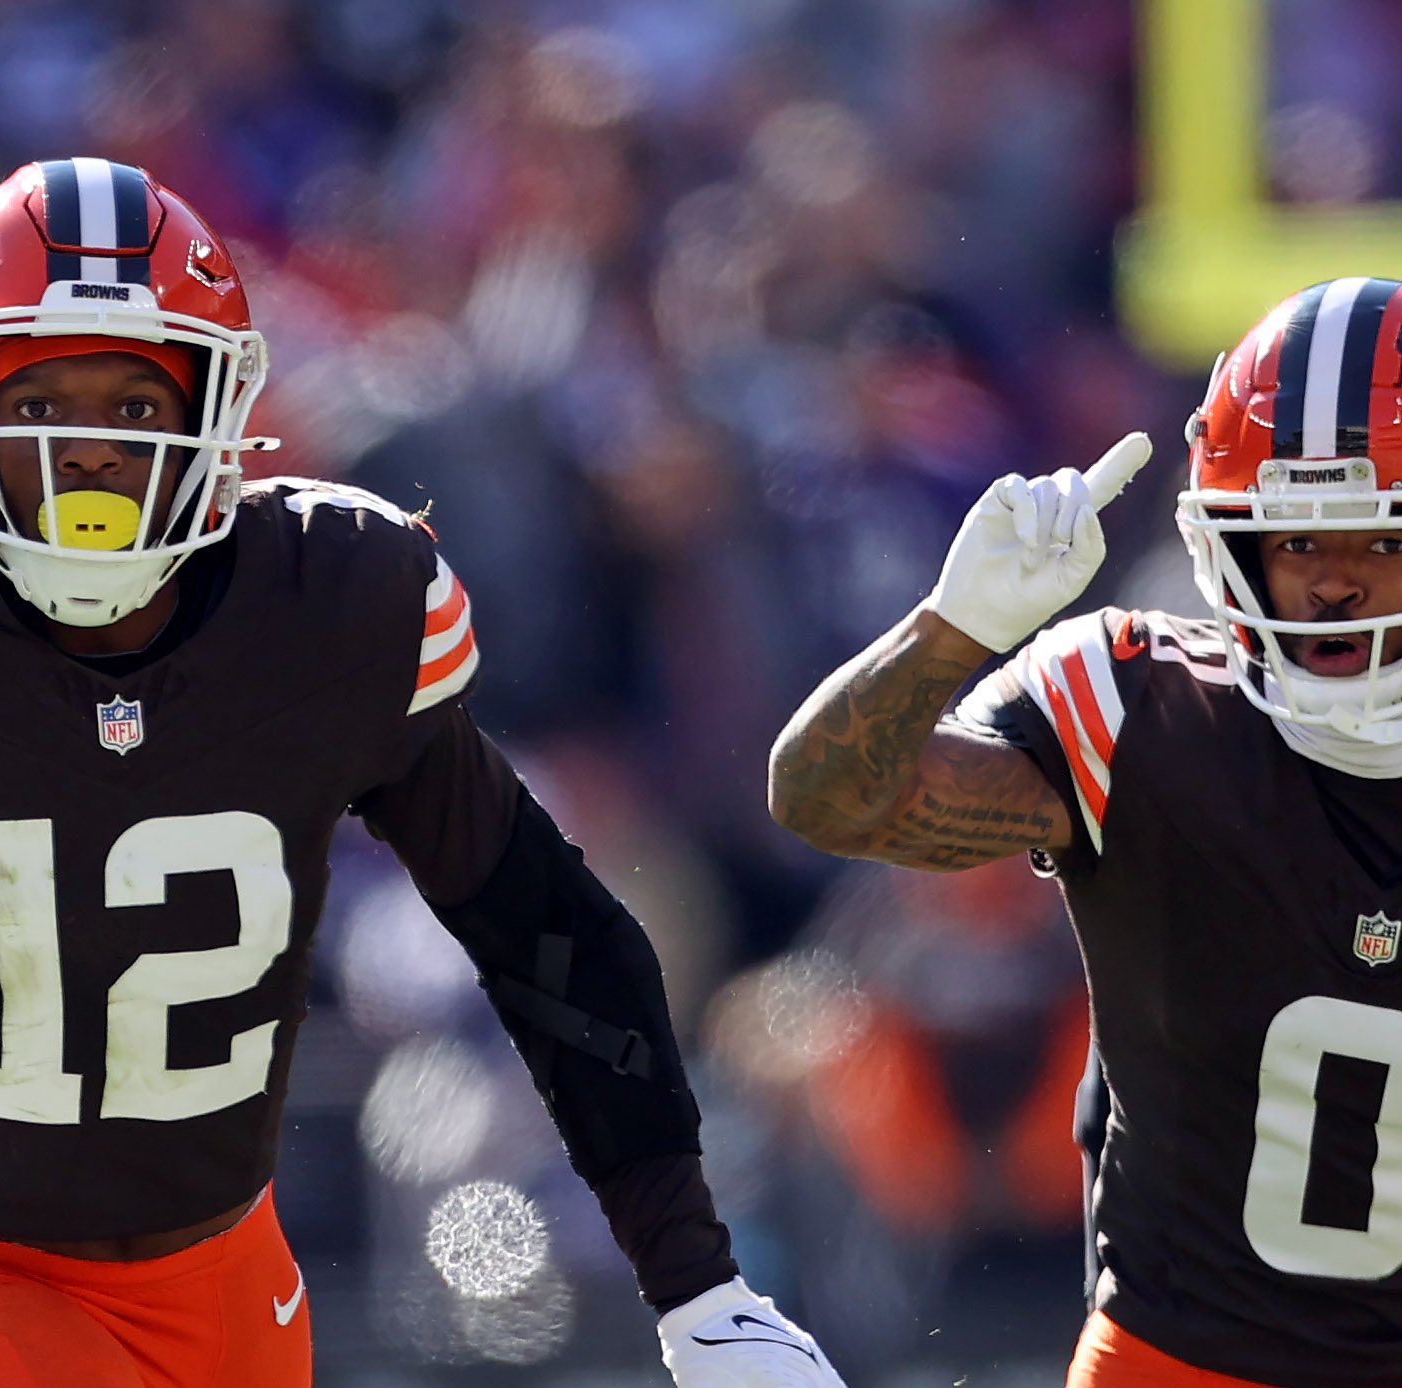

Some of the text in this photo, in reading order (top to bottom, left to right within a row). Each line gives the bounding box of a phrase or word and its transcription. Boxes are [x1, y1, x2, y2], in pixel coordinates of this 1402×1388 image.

[71, 284, 130, 301] BROWNS
[1289, 467, 1346, 484] BROWNS
[106, 722, 137, 743] NFL
[1361, 936, 1389, 957] NFL
